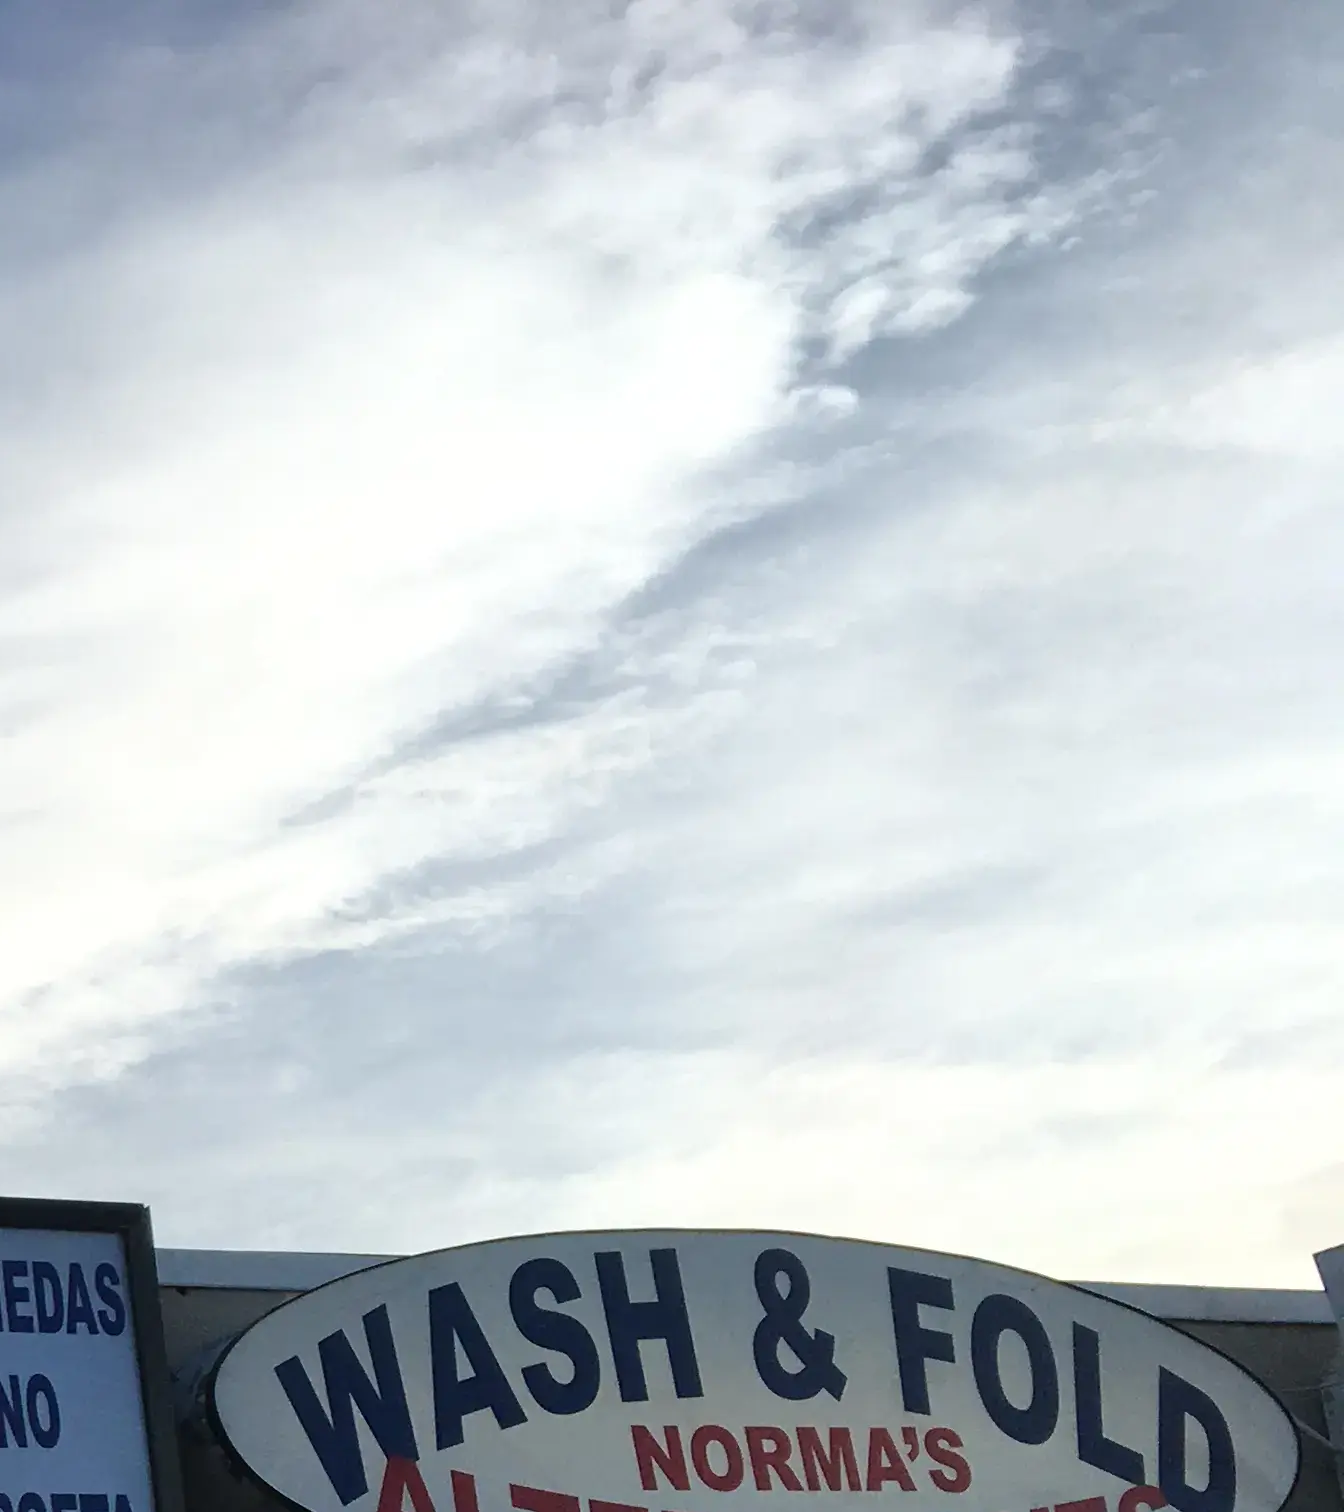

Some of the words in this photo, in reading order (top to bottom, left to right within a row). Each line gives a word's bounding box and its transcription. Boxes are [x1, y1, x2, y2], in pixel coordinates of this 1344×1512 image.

[273, 1247, 705, 1506] WASH
[752, 1248, 848, 1403] &
[629, 1423, 973, 1496] NORMA'S
